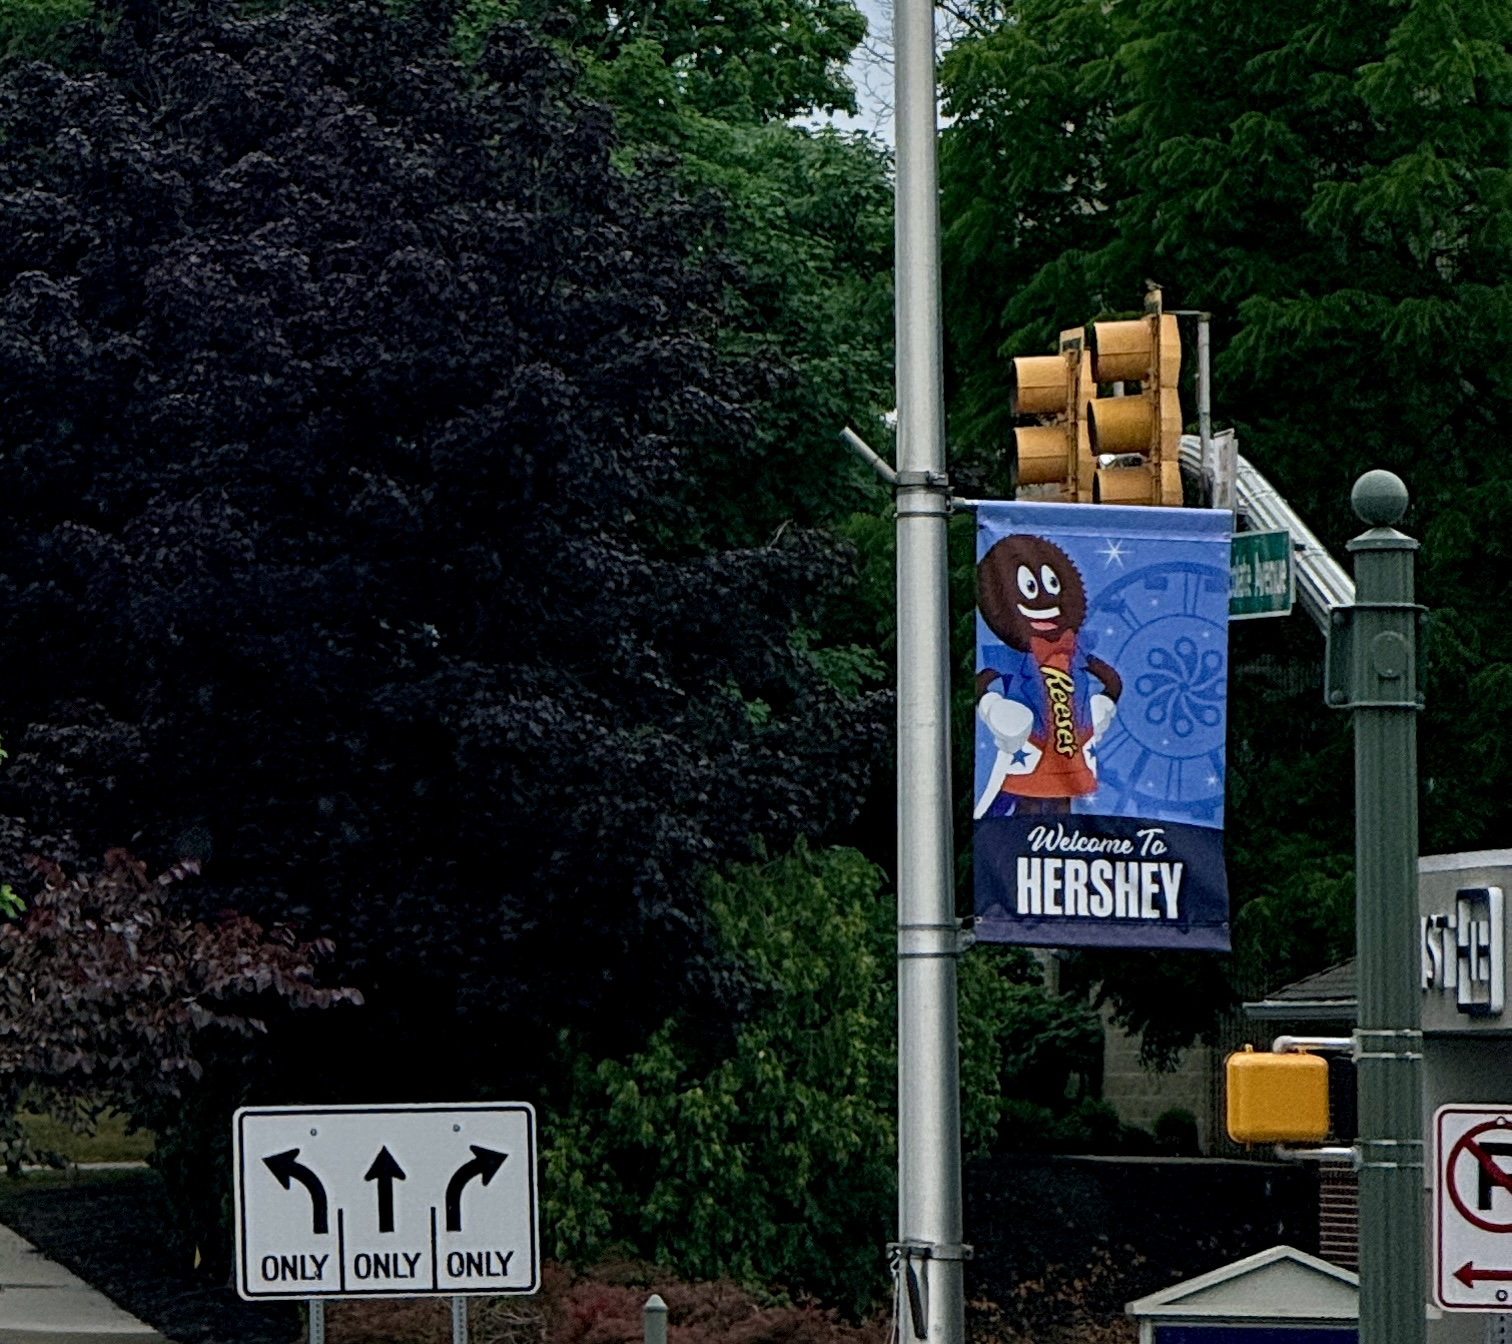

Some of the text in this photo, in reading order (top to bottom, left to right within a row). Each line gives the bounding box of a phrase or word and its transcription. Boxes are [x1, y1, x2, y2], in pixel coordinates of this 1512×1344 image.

[1039, 665, 1079, 759] Reese's
[1027, 822, 1168, 857] Welcome To
[1017, 857, 1184, 919] HERSHEY
[261, 1250, 515, 1281] ONLY ONLY ONLY
